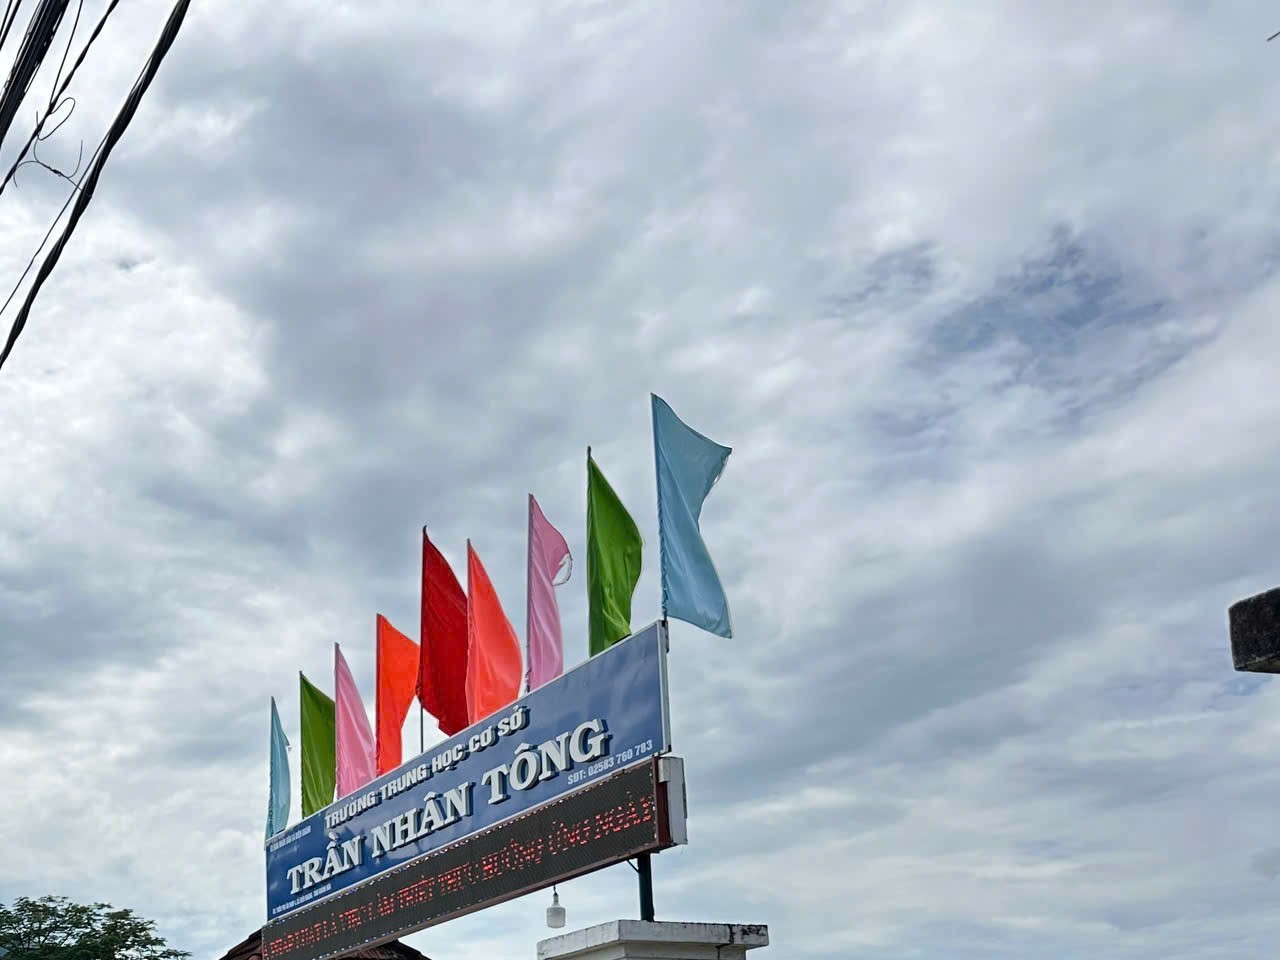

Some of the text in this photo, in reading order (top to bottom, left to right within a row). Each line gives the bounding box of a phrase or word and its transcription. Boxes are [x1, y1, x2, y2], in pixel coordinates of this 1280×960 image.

[286, 719, 611, 895] TRẦN NHÂN TÔNG
[324, 705, 528, 829] TRƯỜNG TRUNG HỌC CƠ SỞ
[588, 757, 614, 776] 02583
[616, 748, 633, 764] 760
[634, 739, 653, 756] 783
